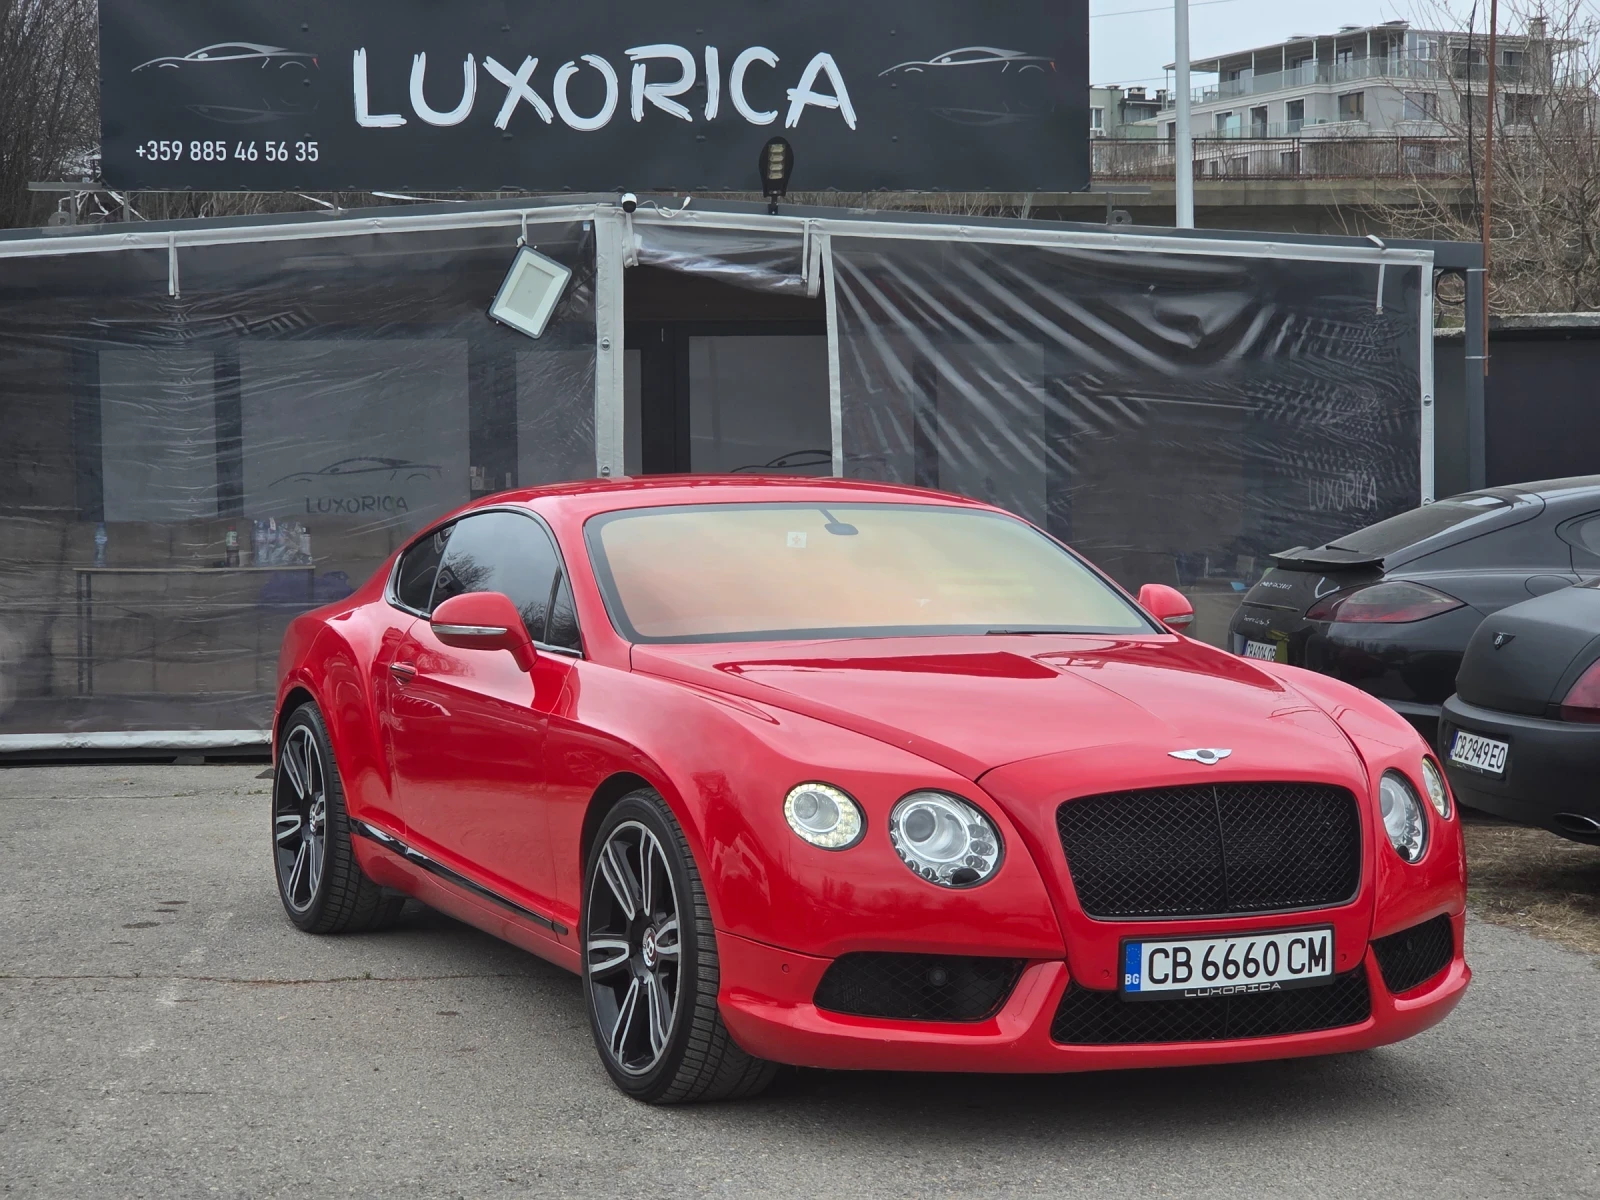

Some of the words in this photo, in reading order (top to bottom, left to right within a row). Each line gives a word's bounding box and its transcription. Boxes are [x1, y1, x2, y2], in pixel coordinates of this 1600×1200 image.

[353, 43, 856, 131] LUXORICA
[135, 140, 183, 161] +359
[189, 141, 227, 161] 885
[234, 141, 258, 162] 46
[265, 141, 289, 162] 56
[295, 141, 319, 162] 35
[305, 495, 409, 514] LUXORICA
[1308, 474, 1378, 511] LUXORICA
[1454, 735, 1467, 759] CB
[1464, 738, 1491, 766] 2949
[1488, 744, 1506, 770] EO
[1148, 946, 1193, 985] CB
[1201, 940, 1280, 981] 6660
[1287, 936, 1327, 975] CM
[1124, 973, 1140, 985] BG
[1184, 981, 1281, 997] LUXORICA
